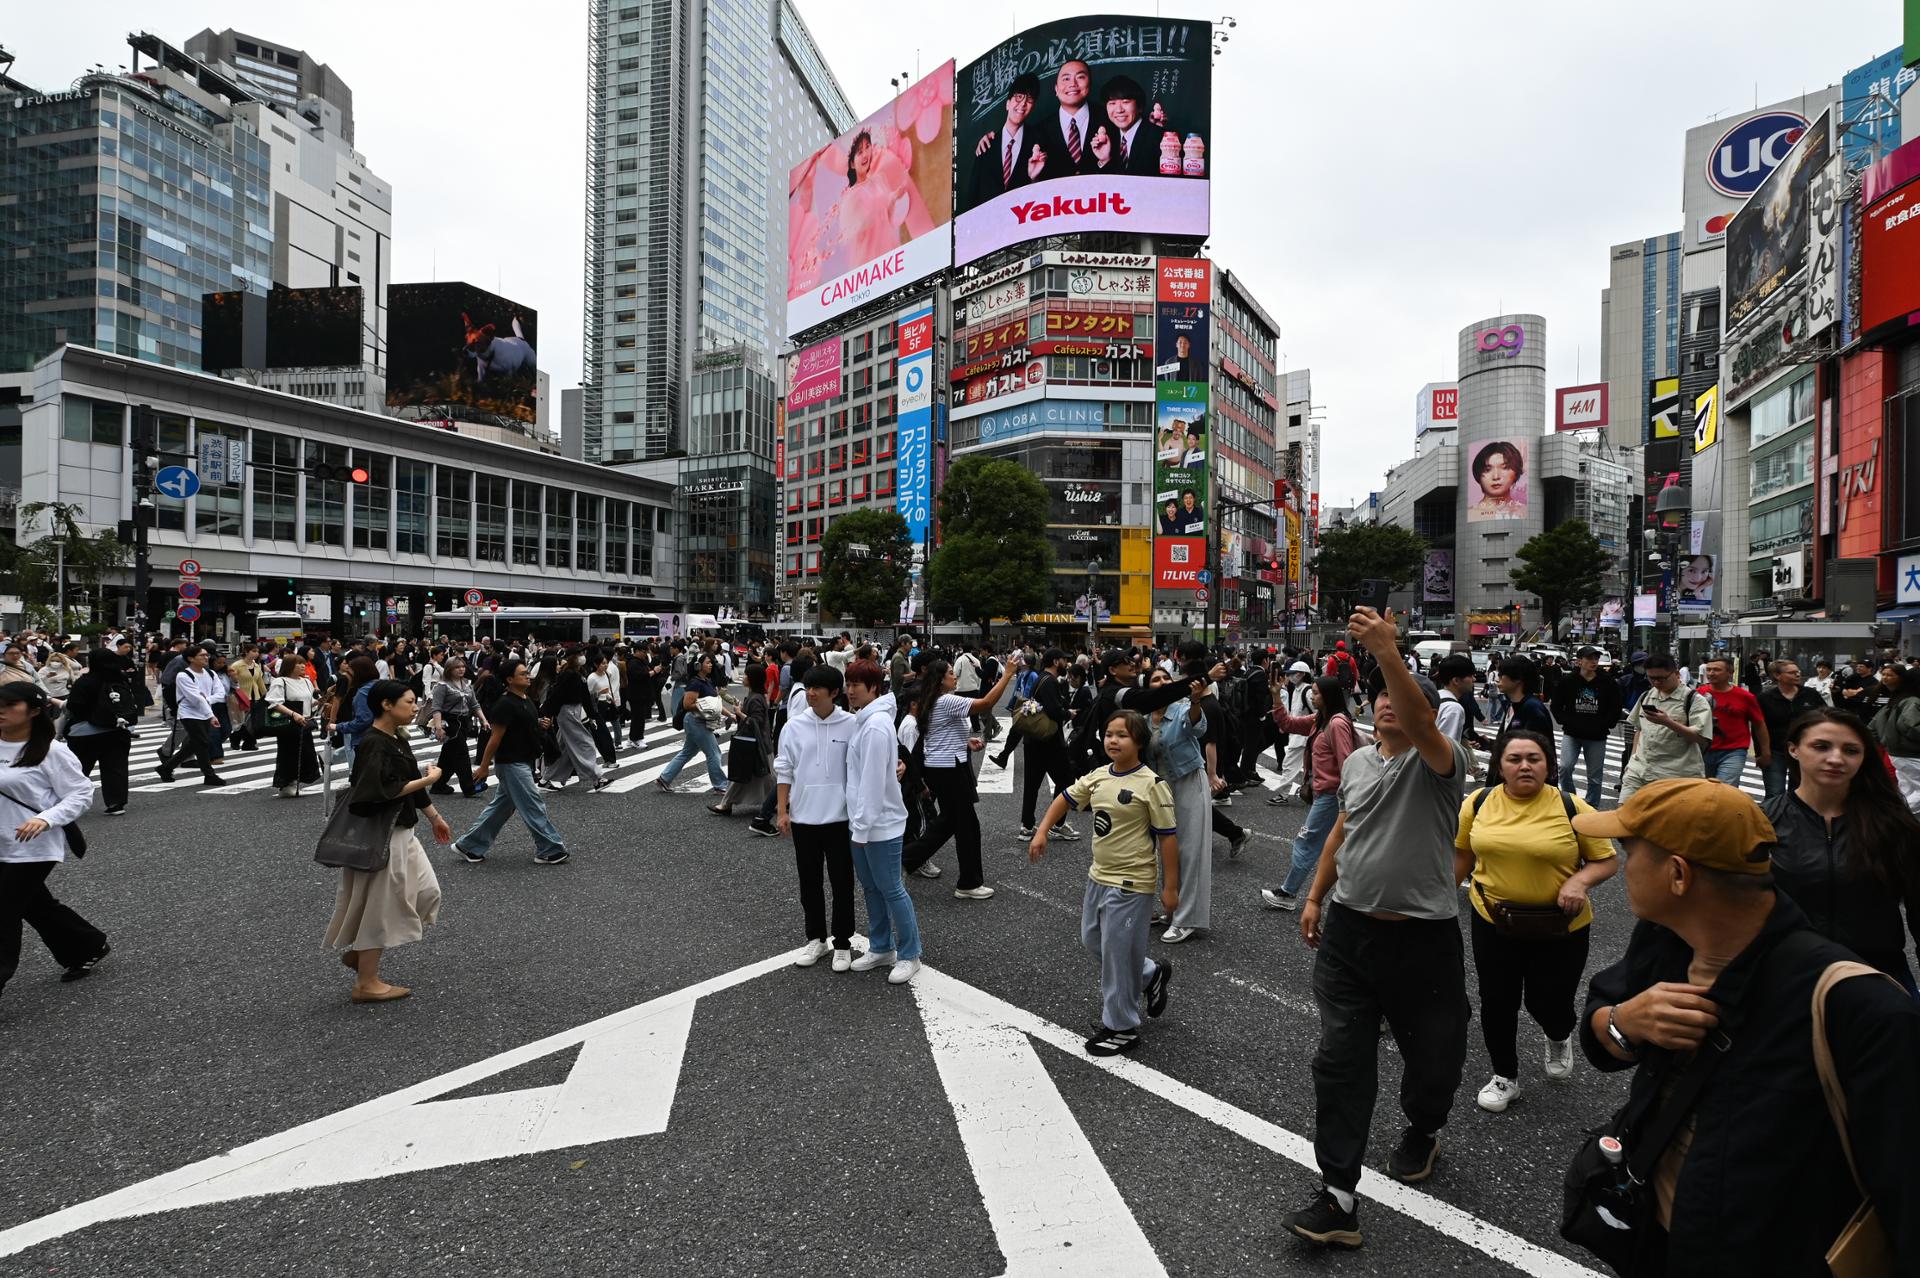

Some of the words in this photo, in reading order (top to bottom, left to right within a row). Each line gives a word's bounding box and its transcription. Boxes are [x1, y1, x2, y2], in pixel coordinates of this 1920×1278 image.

[27, 88, 92, 106] FUKURAS
[134, 103, 172, 128] TOKYU
[174, 127, 210, 149] PLAZA
[1720, 127, 1806, 178] UC
[1010, 192, 1131, 225] Yakult
[1810, 170, 1835, 323] もんじゃ
[1060, 252, 1151, 266] しゃぶしゃぶバイキング
[820, 250, 905, 307] CANMAKE
[960, 261, 1025, 296] しゃぶしゃぶバイキング
[1163, 267, 1205, 279] 公式番組
[1097, 274, 1151, 293] しゃぶ葉
[1170, 281, 1198, 290] 毎週月曜
[850, 289, 871, 304] TOKYO
[988, 281, 1026, 309] しゃぶ葉
[1173, 290, 1195, 298] 19:00
[955, 308, 966, 320] 9F
[1047, 314, 1131, 333] コンタクト
[904, 321, 928, 340] 当ビル
[968, 321, 1027, 354] プライス
[909, 337, 922, 350] 5F
[1105, 343, 1144, 360] ガスト
[1475, 326, 1524, 358] 109
[1002, 346, 1032, 369] ガスト
[985, 373, 1022, 397] ガスト
[901, 392, 928, 407] eyecity
[954, 388, 966, 403] 7F
[1436, 393, 1455, 404] UN
[1569, 398, 1596, 416] H&M
[1003, 412, 1037, 429] AOBA
[1047, 409, 1104, 422] CLINIC
[210, 438, 222, 480] 渋谷駅前
[900, 429, 914, 523] アイシティ
[915, 426, 926, 522] コンタクトの
[684, 484, 715, 492] MARK
[719, 480, 745, 490] CITY
[1162, 570, 1197, 581] 17LIVE
[1256, 585, 1272, 600] LUSH
